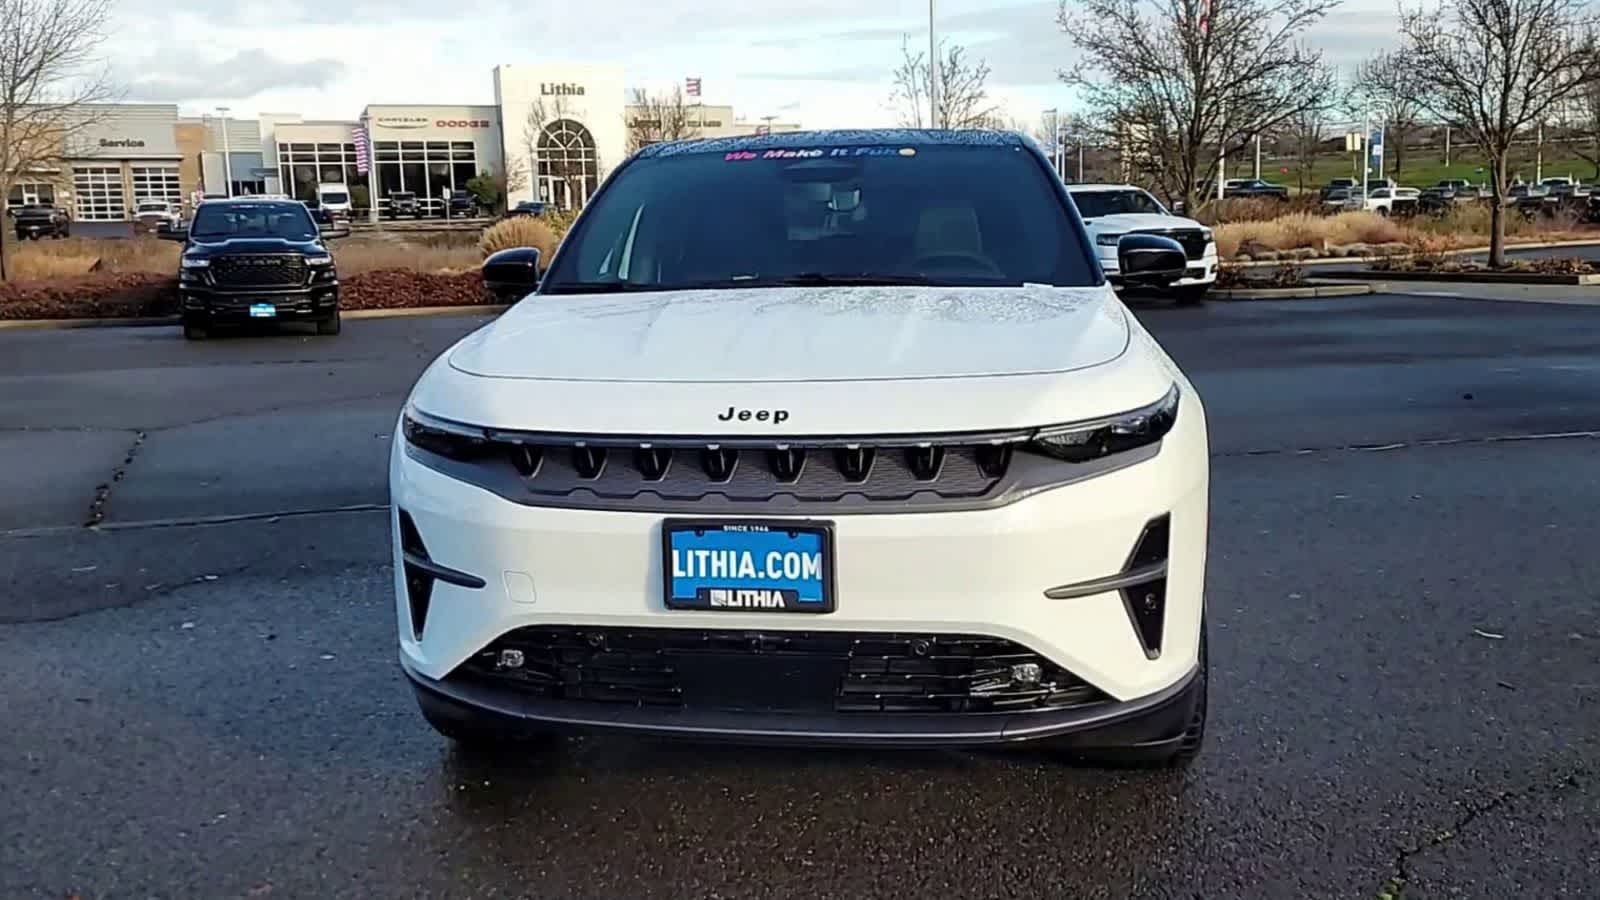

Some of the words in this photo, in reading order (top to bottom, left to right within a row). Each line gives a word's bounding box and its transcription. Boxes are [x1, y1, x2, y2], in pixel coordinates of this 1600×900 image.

[540, 82, 585, 96] Lithia
[436, 120, 490, 128] DODGE
[99, 138, 145, 147] Service
[724, 151, 756, 161] We
[763, 149, 824, 159] Make
[718, 407, 789, 424] Jeep
[672, 549, 822, 580] LITHIA.COM
[727, 589, 786, 608] LITHIA
